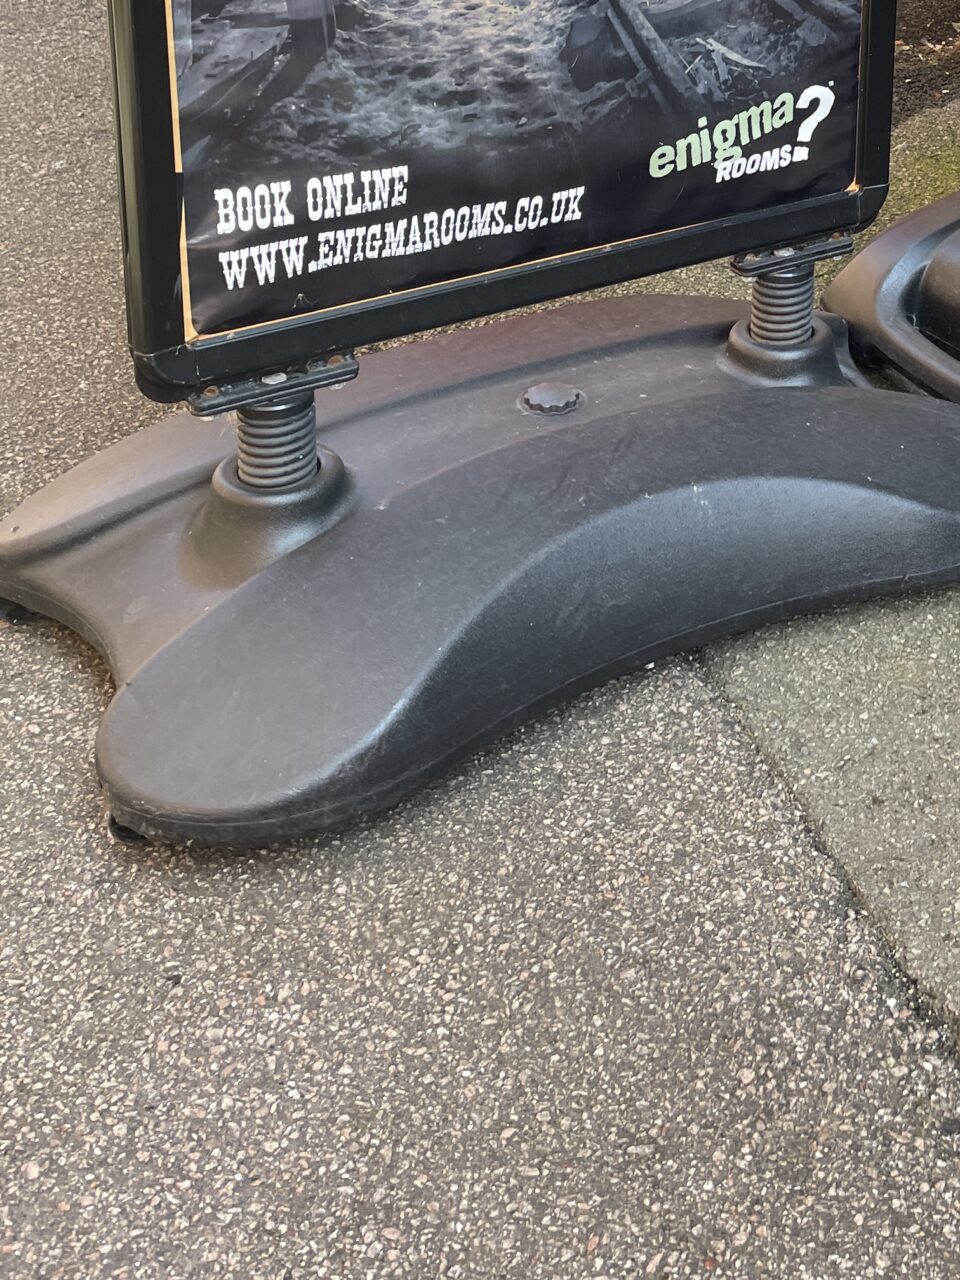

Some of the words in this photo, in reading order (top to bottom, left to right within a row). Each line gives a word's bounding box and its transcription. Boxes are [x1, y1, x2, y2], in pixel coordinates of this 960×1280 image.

[715, 143, 792, 184] ROOMS
[213, 180, 295, 235] BOOK
[306, 164, 409, 222] ONLINE
[218, 185, 586, 291] WWW.ENIGMAROOMS.CO.UK
